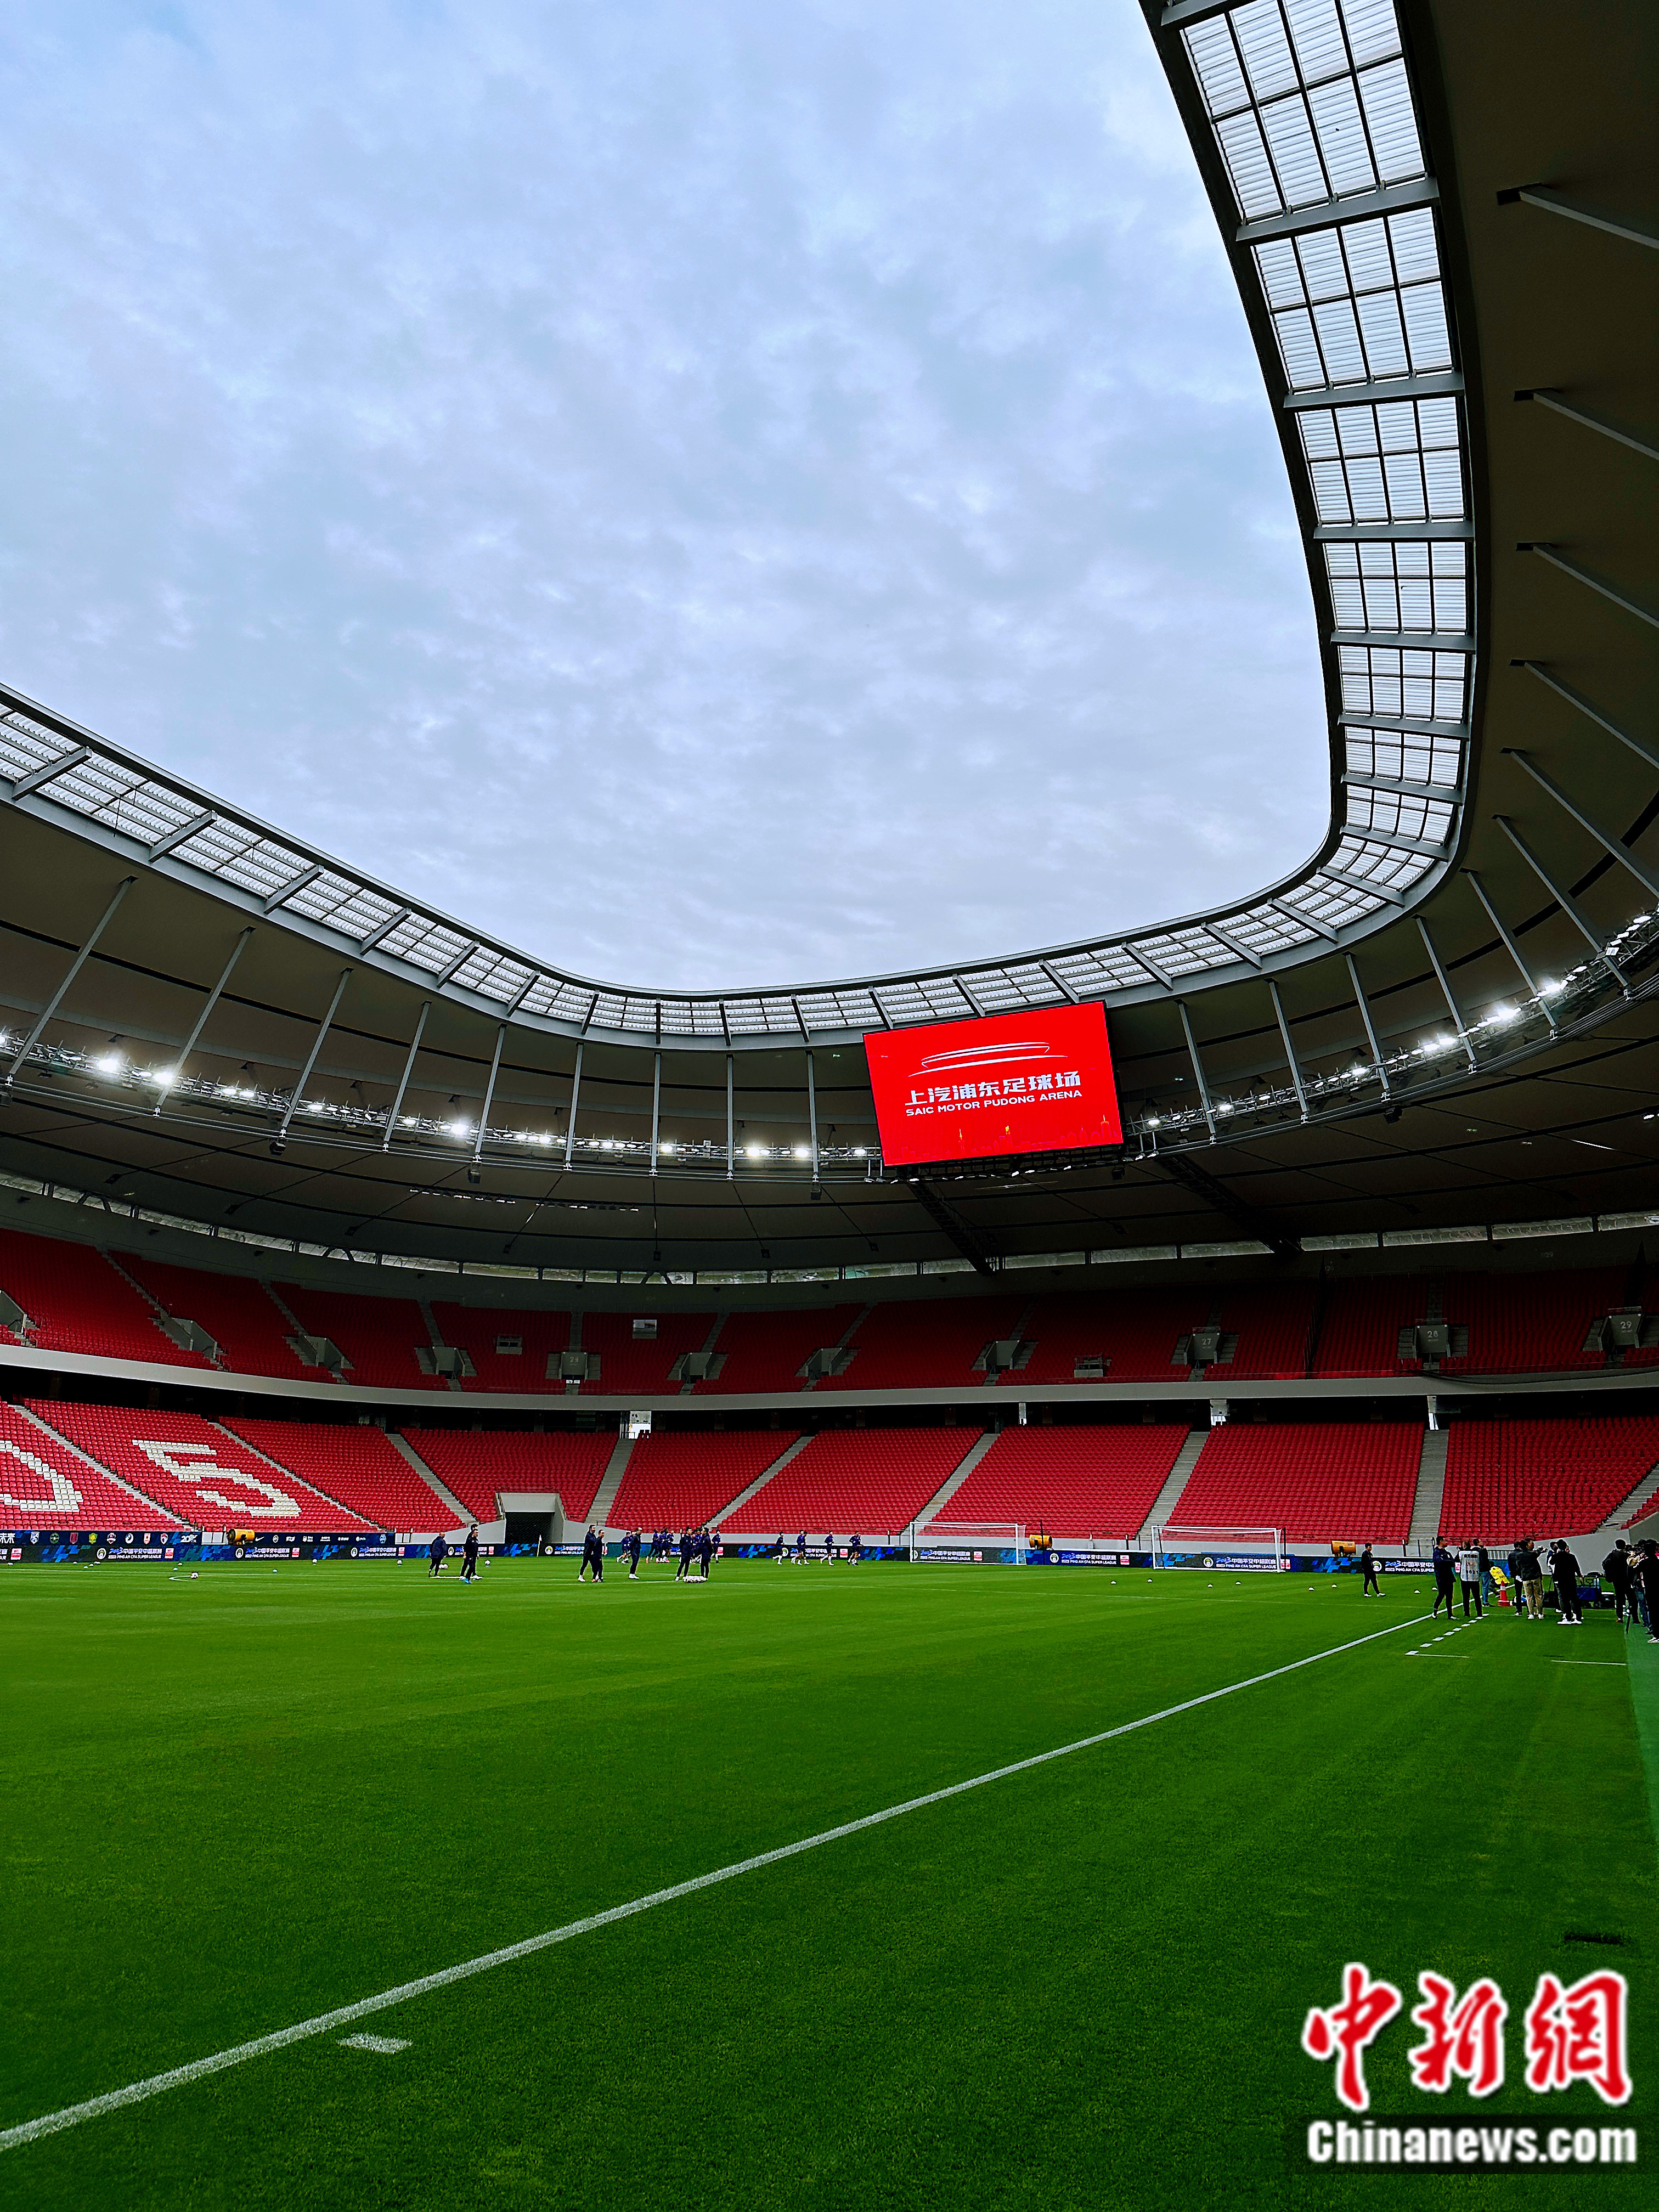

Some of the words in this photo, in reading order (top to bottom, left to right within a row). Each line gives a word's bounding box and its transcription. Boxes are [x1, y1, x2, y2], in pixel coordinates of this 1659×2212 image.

[905, 1071, 1081, 1106] 上汽浦东足球场
[906, 1105, 934, 1116] SAIC
[938, 1101, 980, 1113] MOTOR
[984, 1095, 1035, 1108] PUDONG
[1039, 1089, 1082, 1101] ARENA
[1620, 1321, 1632, 1329] 29
